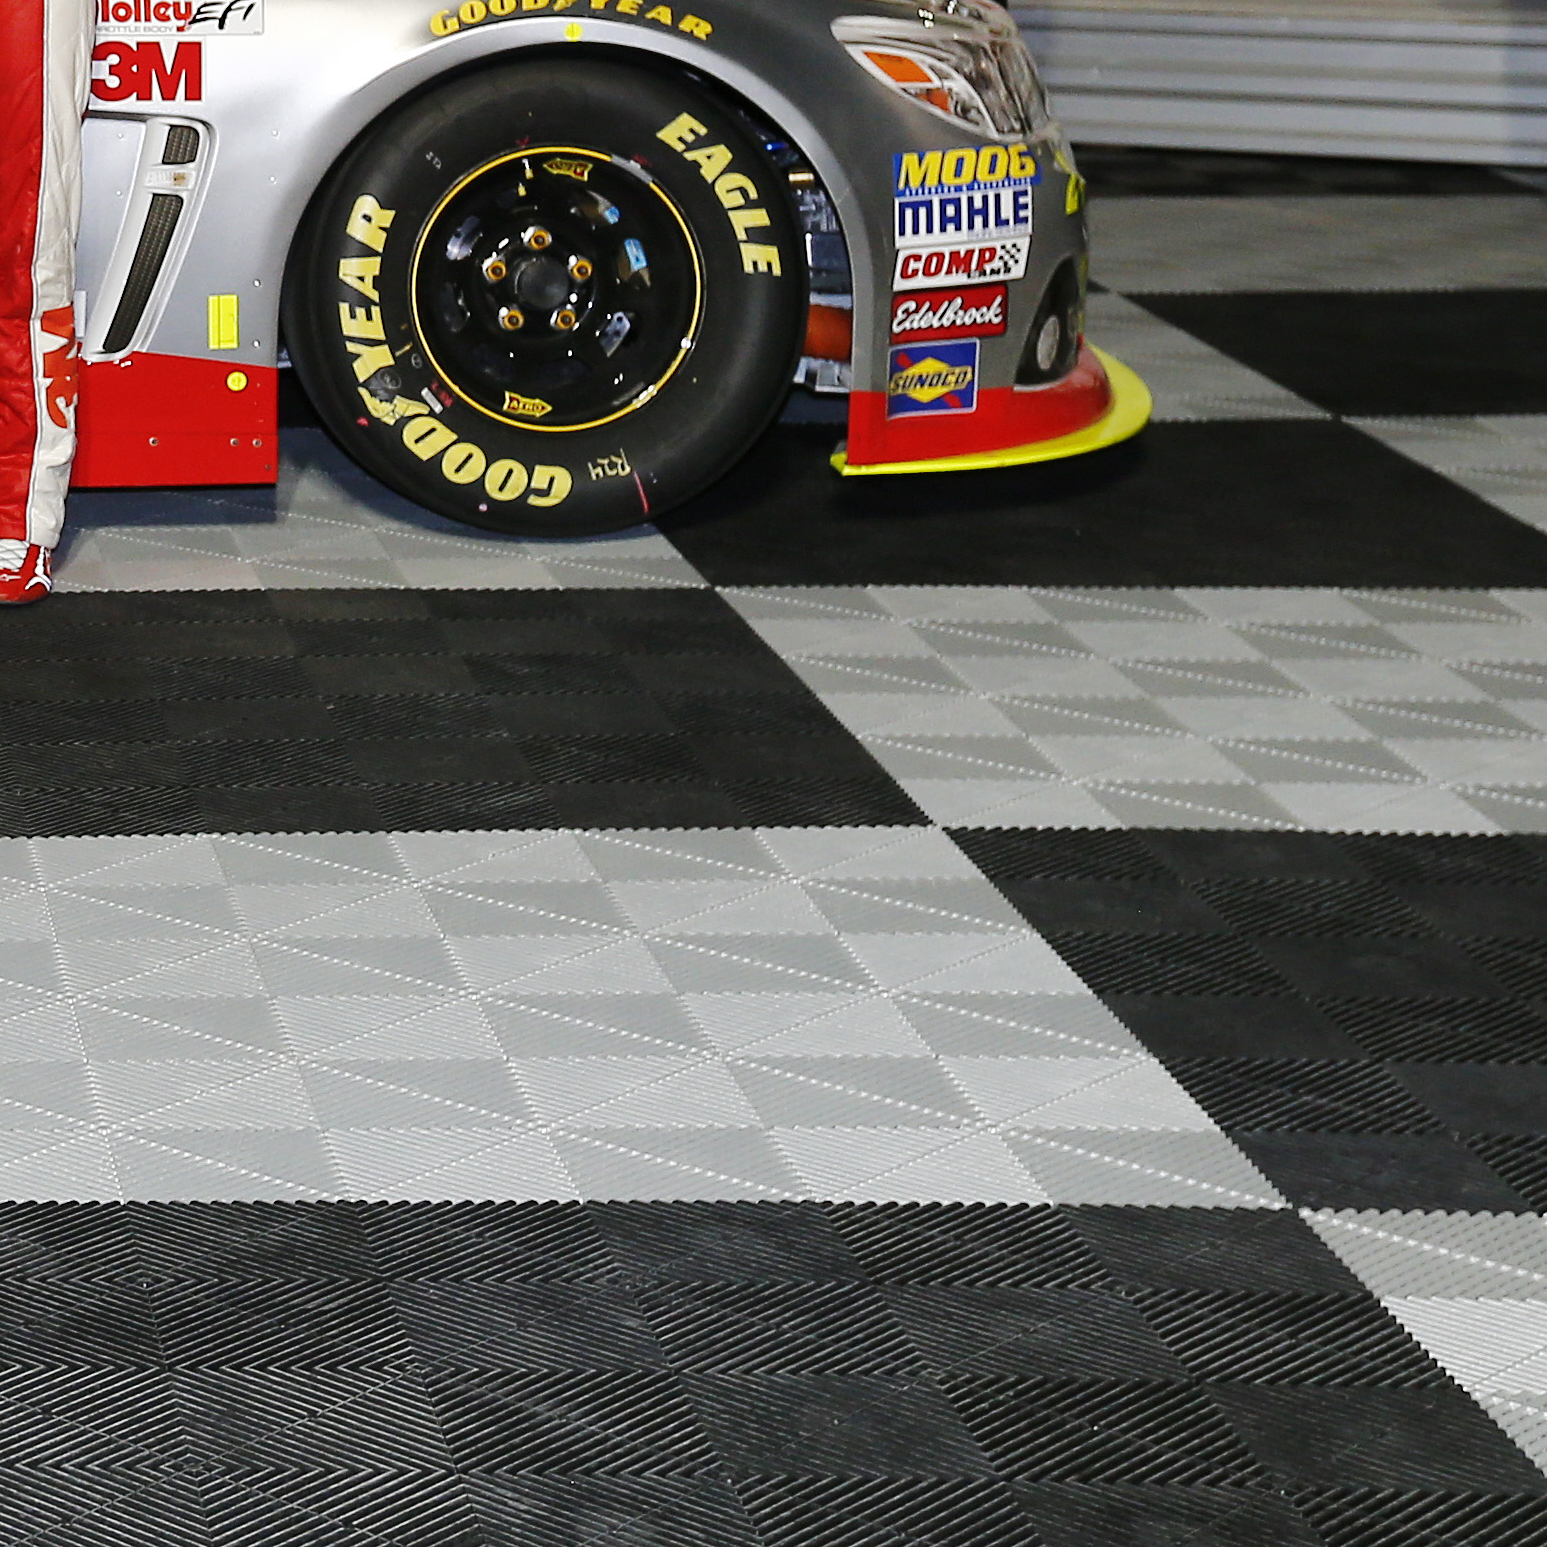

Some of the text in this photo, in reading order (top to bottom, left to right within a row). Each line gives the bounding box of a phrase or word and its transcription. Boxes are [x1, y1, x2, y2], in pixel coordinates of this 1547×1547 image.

[91, 41, 203, 102] 3M
[898, 142, 1036, 191] MOOG
[655, 110, 783, 279] EAGLE
[898, 189, 1029, 237] MAHLE
[900, 247, 998, 280] COMP
[891, 295, 1004, 335] Edelbrock
[338, 192, 574, 509] GOODYEAR
[890, 365, 972, 394] SUNOCO
